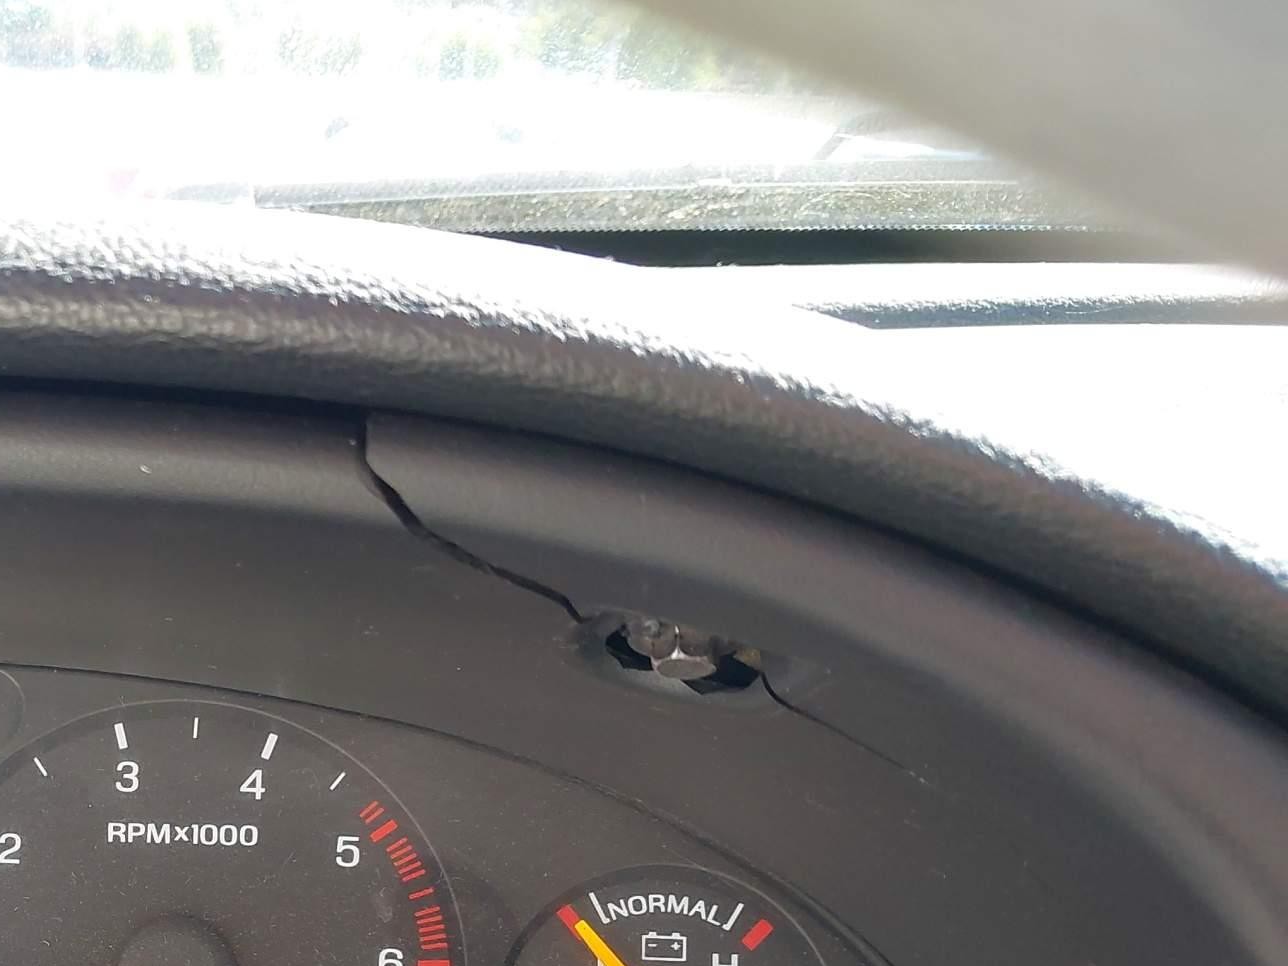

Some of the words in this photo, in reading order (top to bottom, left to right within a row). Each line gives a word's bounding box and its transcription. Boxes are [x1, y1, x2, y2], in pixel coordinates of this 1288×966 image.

[116, 762, 138, 792] 3
[240, 770, 265, 799] 4
[0, 833, 21, 864] 2
[336, 836, 359, 867] 5
[606, 895, 720, 925] NORMAL
